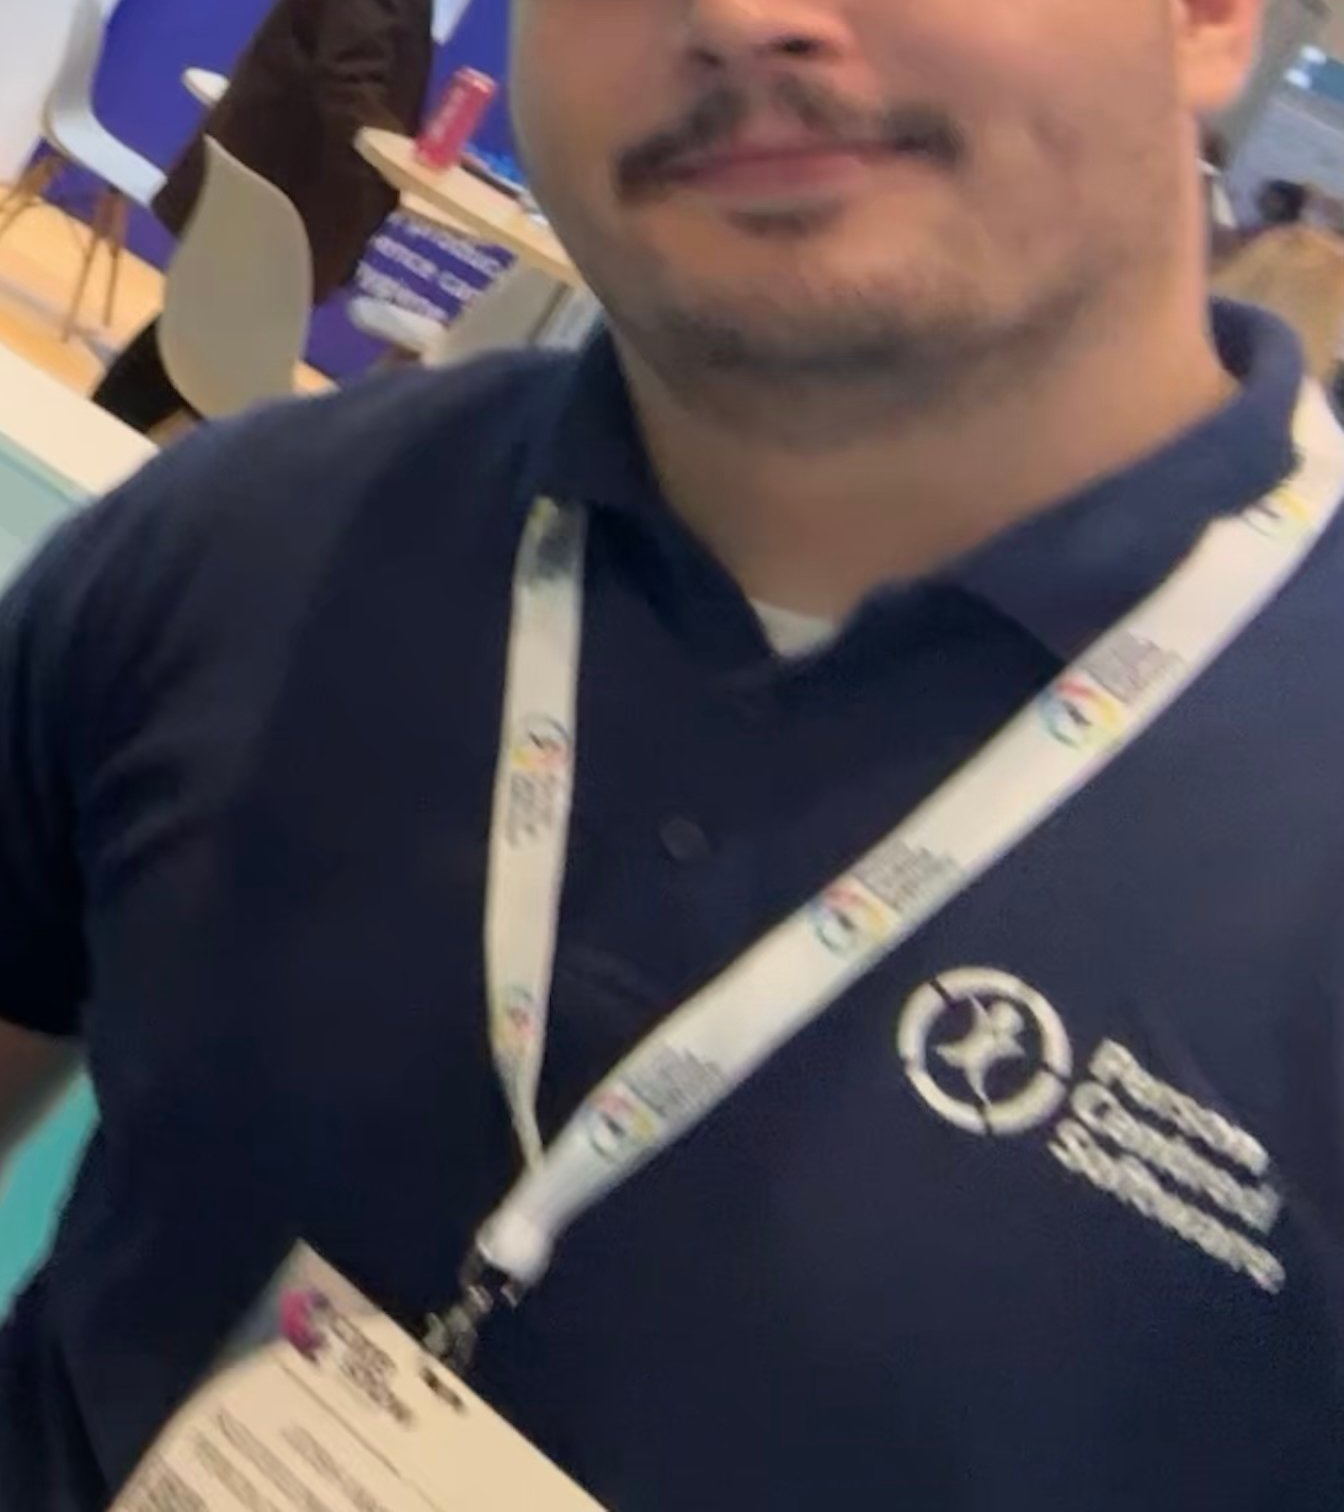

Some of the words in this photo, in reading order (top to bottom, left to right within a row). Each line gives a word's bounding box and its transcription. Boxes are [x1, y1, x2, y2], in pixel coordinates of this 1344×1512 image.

[1070, 1080, 1282, 1236] Centred
[1088, 1036, 1270, 1178] Person
[1045, 1117, 1288, 1295] Software
